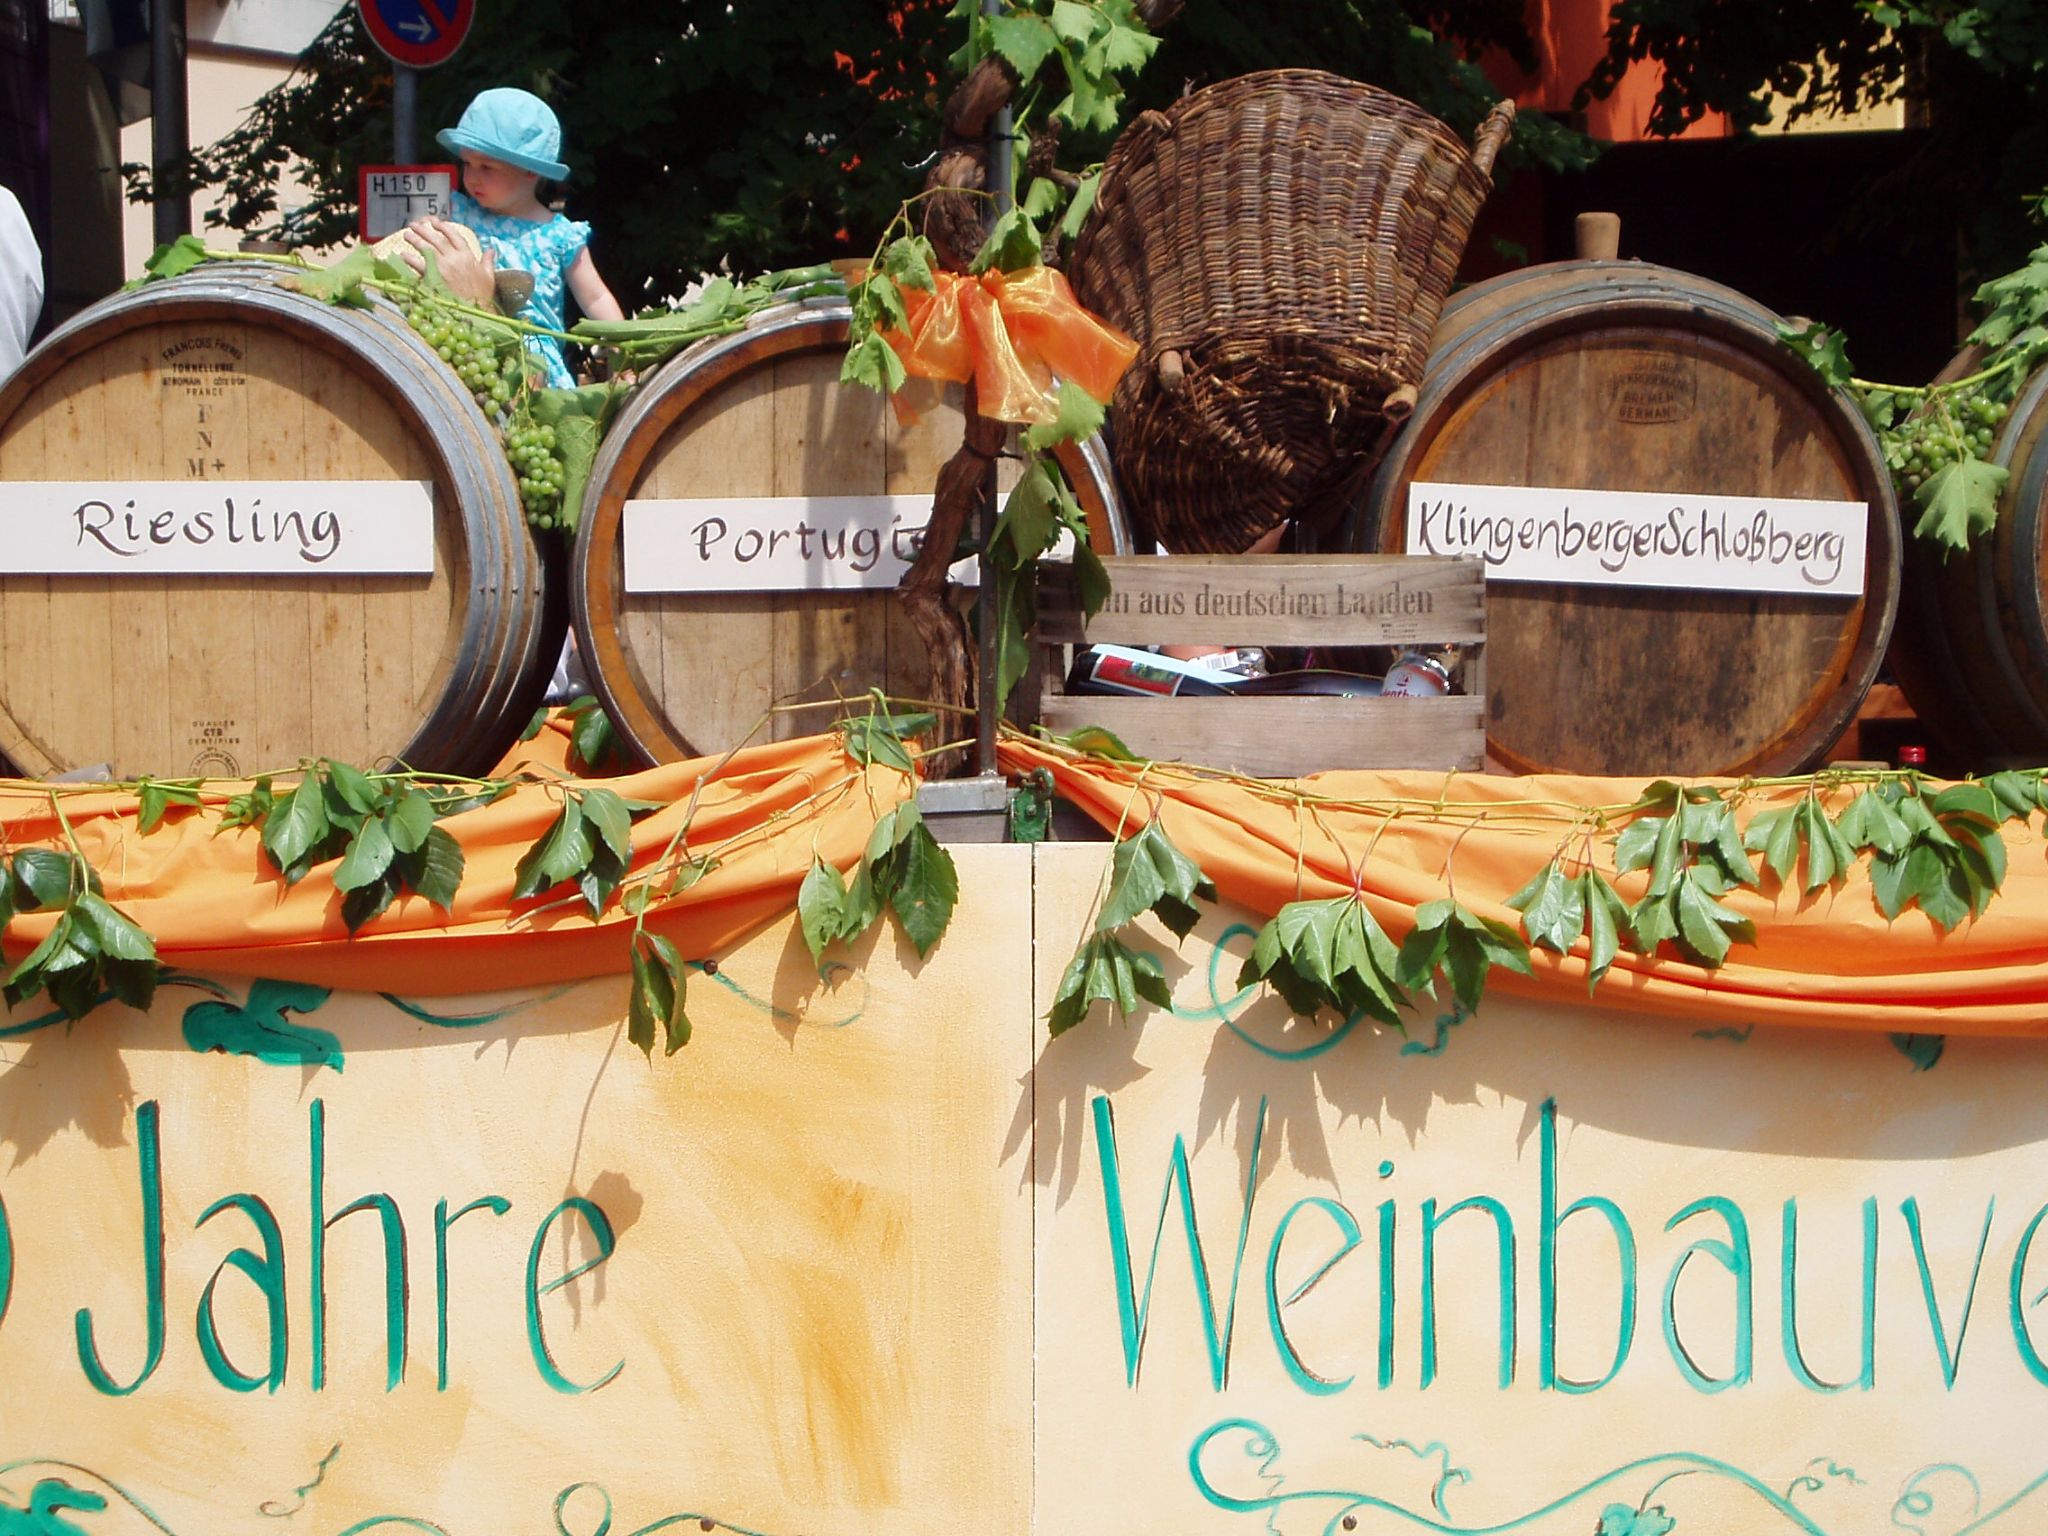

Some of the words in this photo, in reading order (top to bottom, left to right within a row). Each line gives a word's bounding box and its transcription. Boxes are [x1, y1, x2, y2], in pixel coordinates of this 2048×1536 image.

[186, 387, 223, 397] FRANCE
[73, 498, 341, 562] Riesling
[1139, 591, 1185, 615] aus
[1195, 583, 1327, 616] deutschen
[1337, 581, 1433, 615] Landen
[76, 1098, 625, 1397] Jahre
